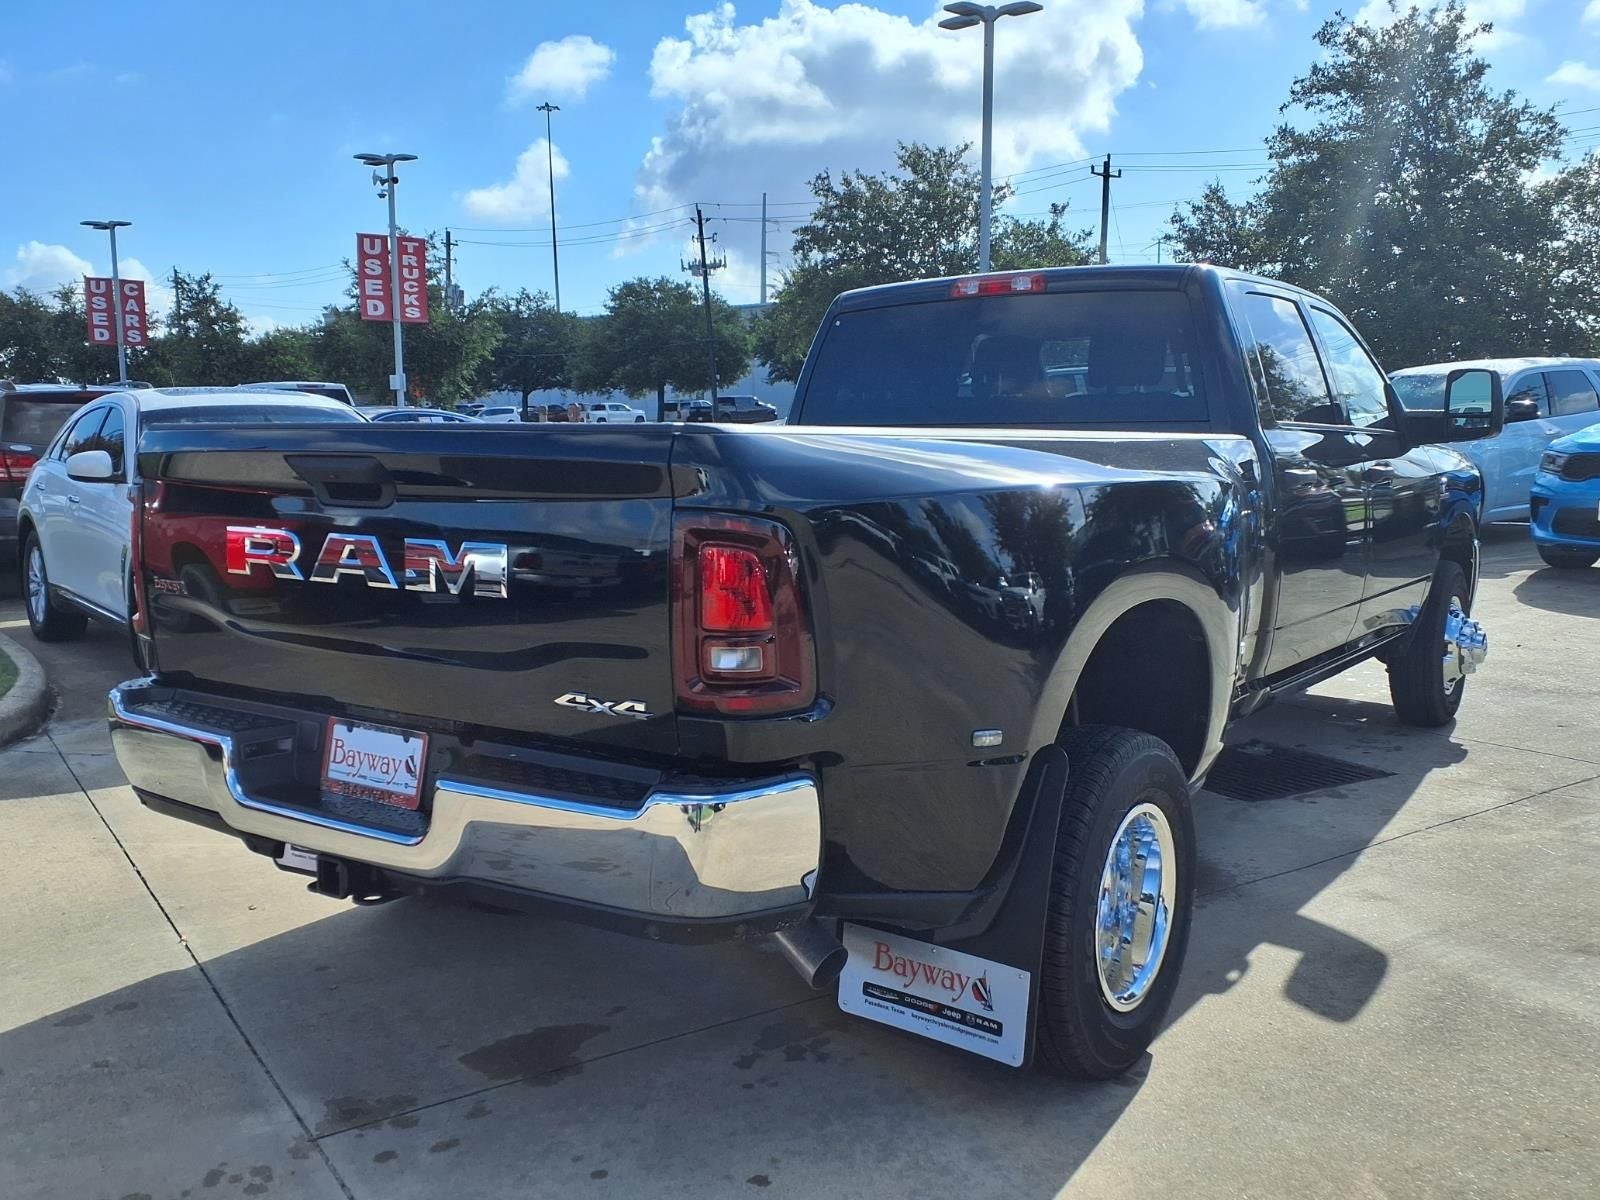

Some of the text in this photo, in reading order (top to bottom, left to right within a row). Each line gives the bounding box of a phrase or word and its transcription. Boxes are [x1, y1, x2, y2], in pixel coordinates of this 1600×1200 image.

[363, 238, 385, 316] USED
[402, 241, 421, 318] TRUCKS
[90, 280, 110, 341] USED
[123, 283, 142, 343] CARS
[226, 525, 508, 599] RAM
[331, 738, 402, 785] Bayway
[872, 941, 971, 1002] Bayway
[904, 996, 934, 1009] DODGE
[942, 1008, 962, 1019] Jeep
[976, 1018, 998, 1030] RAM
